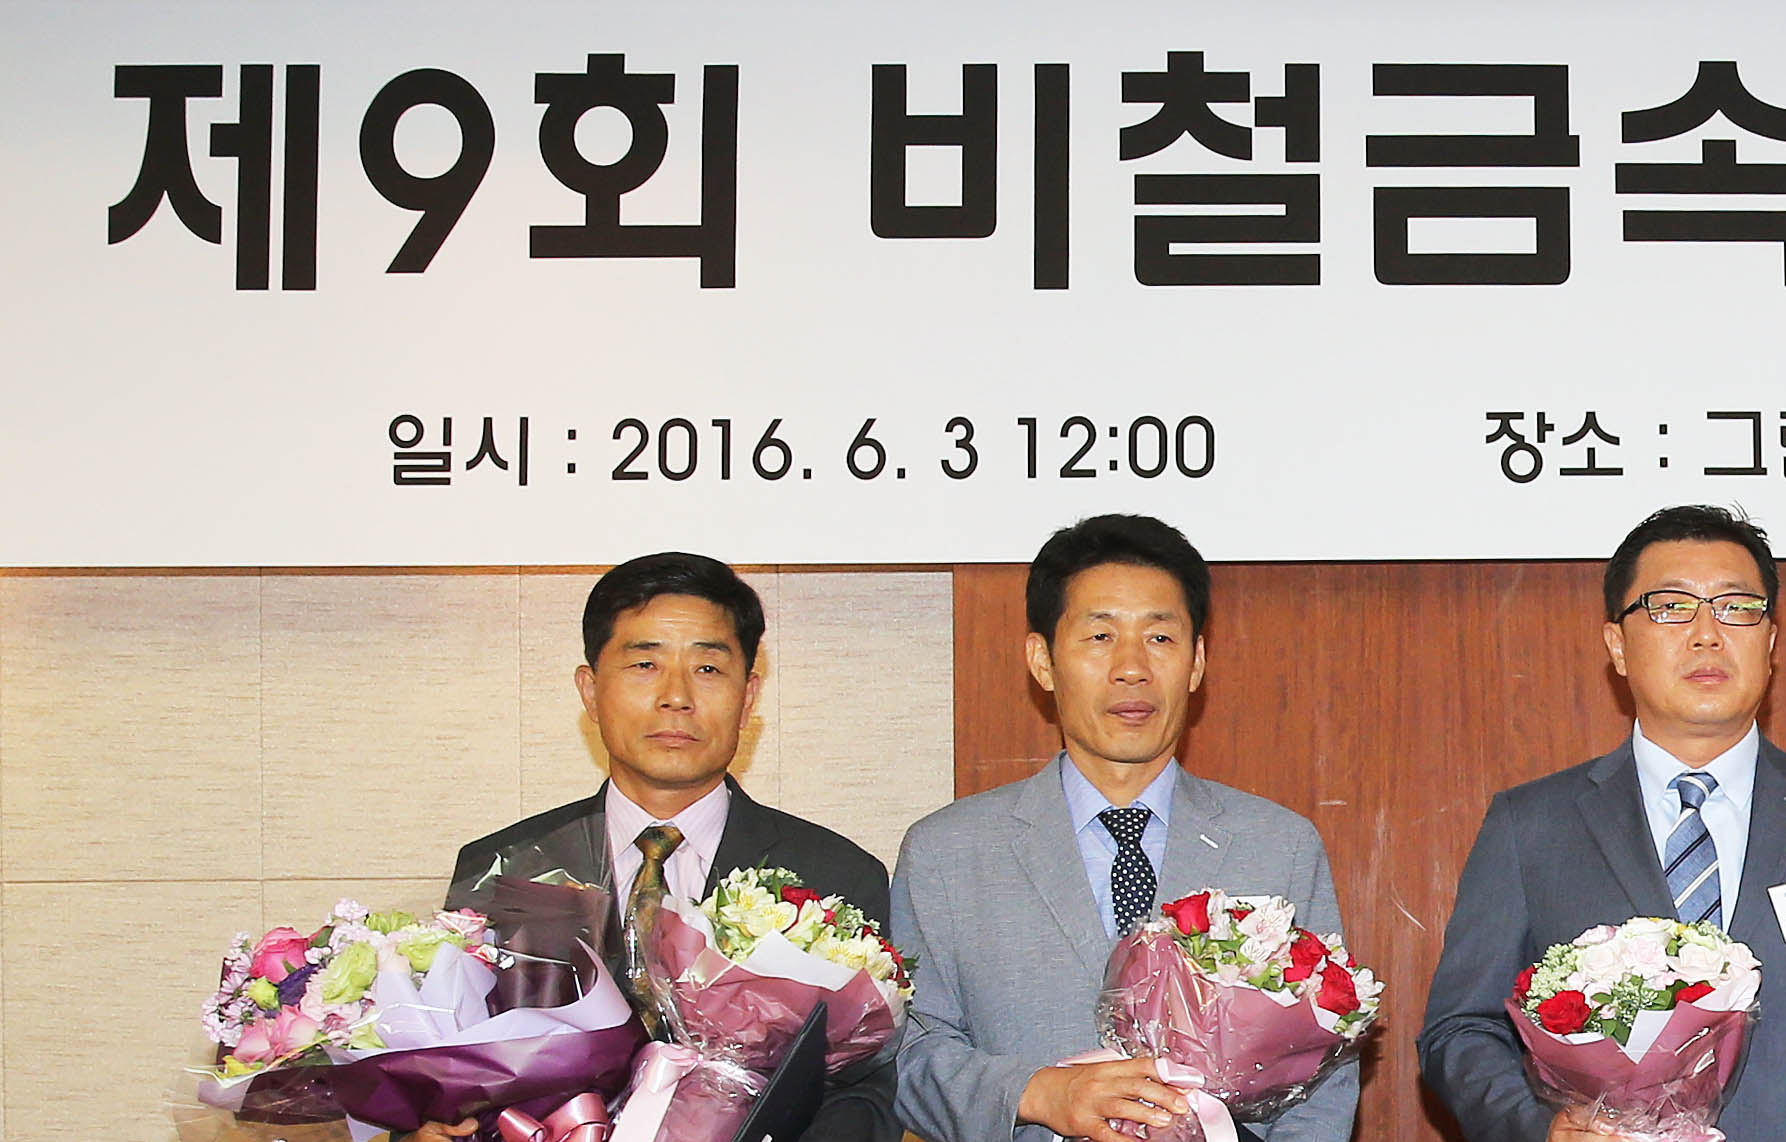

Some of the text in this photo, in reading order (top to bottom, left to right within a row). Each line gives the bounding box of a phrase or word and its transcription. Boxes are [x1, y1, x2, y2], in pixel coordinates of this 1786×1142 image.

[107, 53, 738, 290] 제9회
[388, 414, 1214, 486] 일시 : 2016. 6. 3 12:00
[1485, 411, 1623, 483] 장소
[1659, 423, 1667, 467] :
